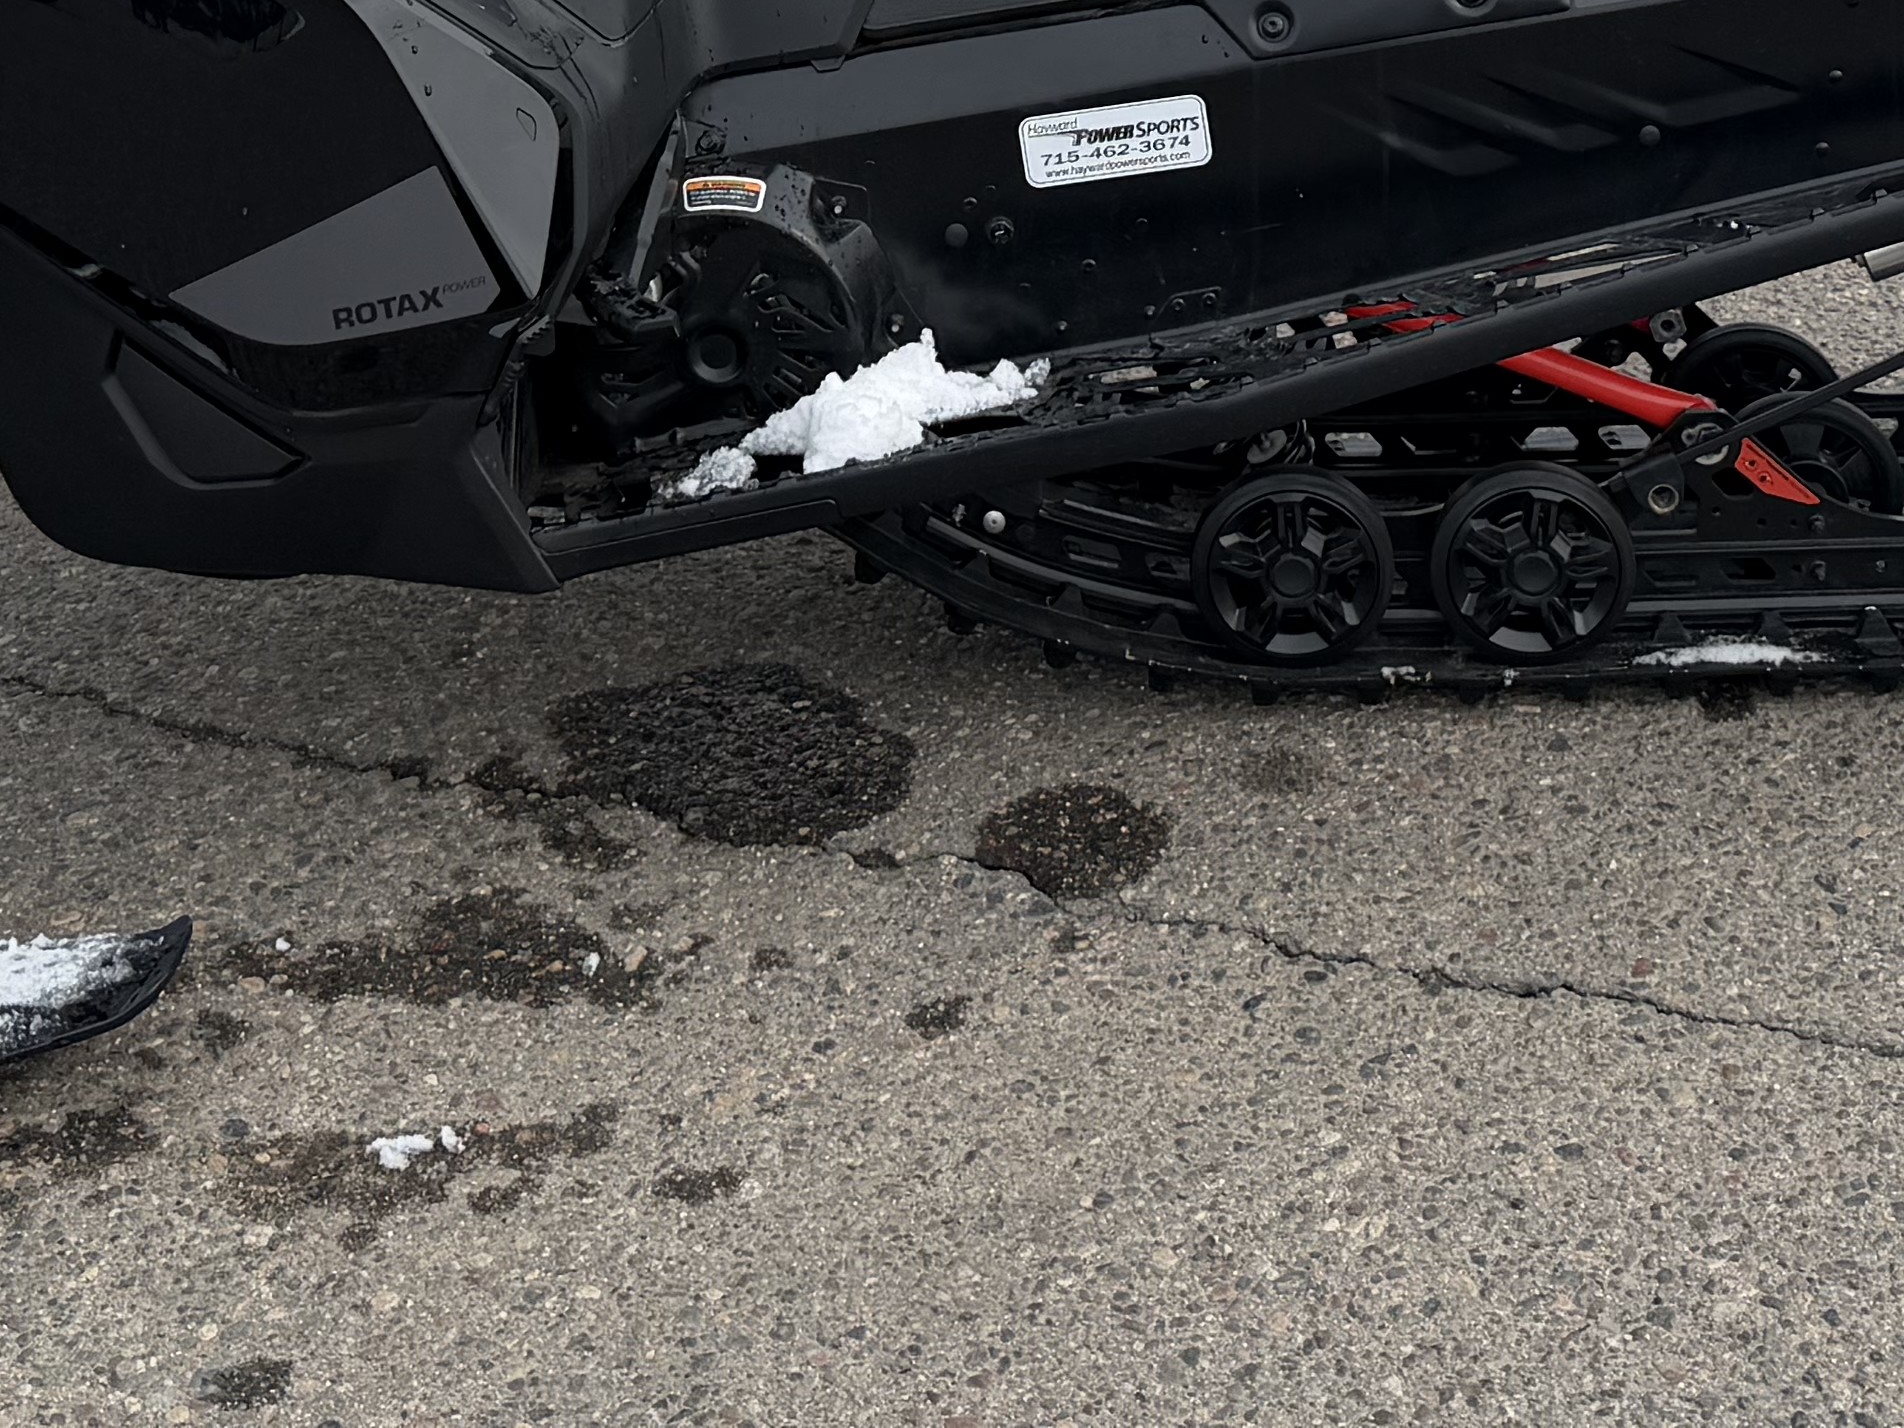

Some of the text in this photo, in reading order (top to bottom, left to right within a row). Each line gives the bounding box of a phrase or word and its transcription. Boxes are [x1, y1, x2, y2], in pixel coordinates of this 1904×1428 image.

[1027, 117, 1079, 136] Hayward
[1040, 134, 1191, 167] 715-462-3674
[332, 275, 487, 331] ROTAX POWER
